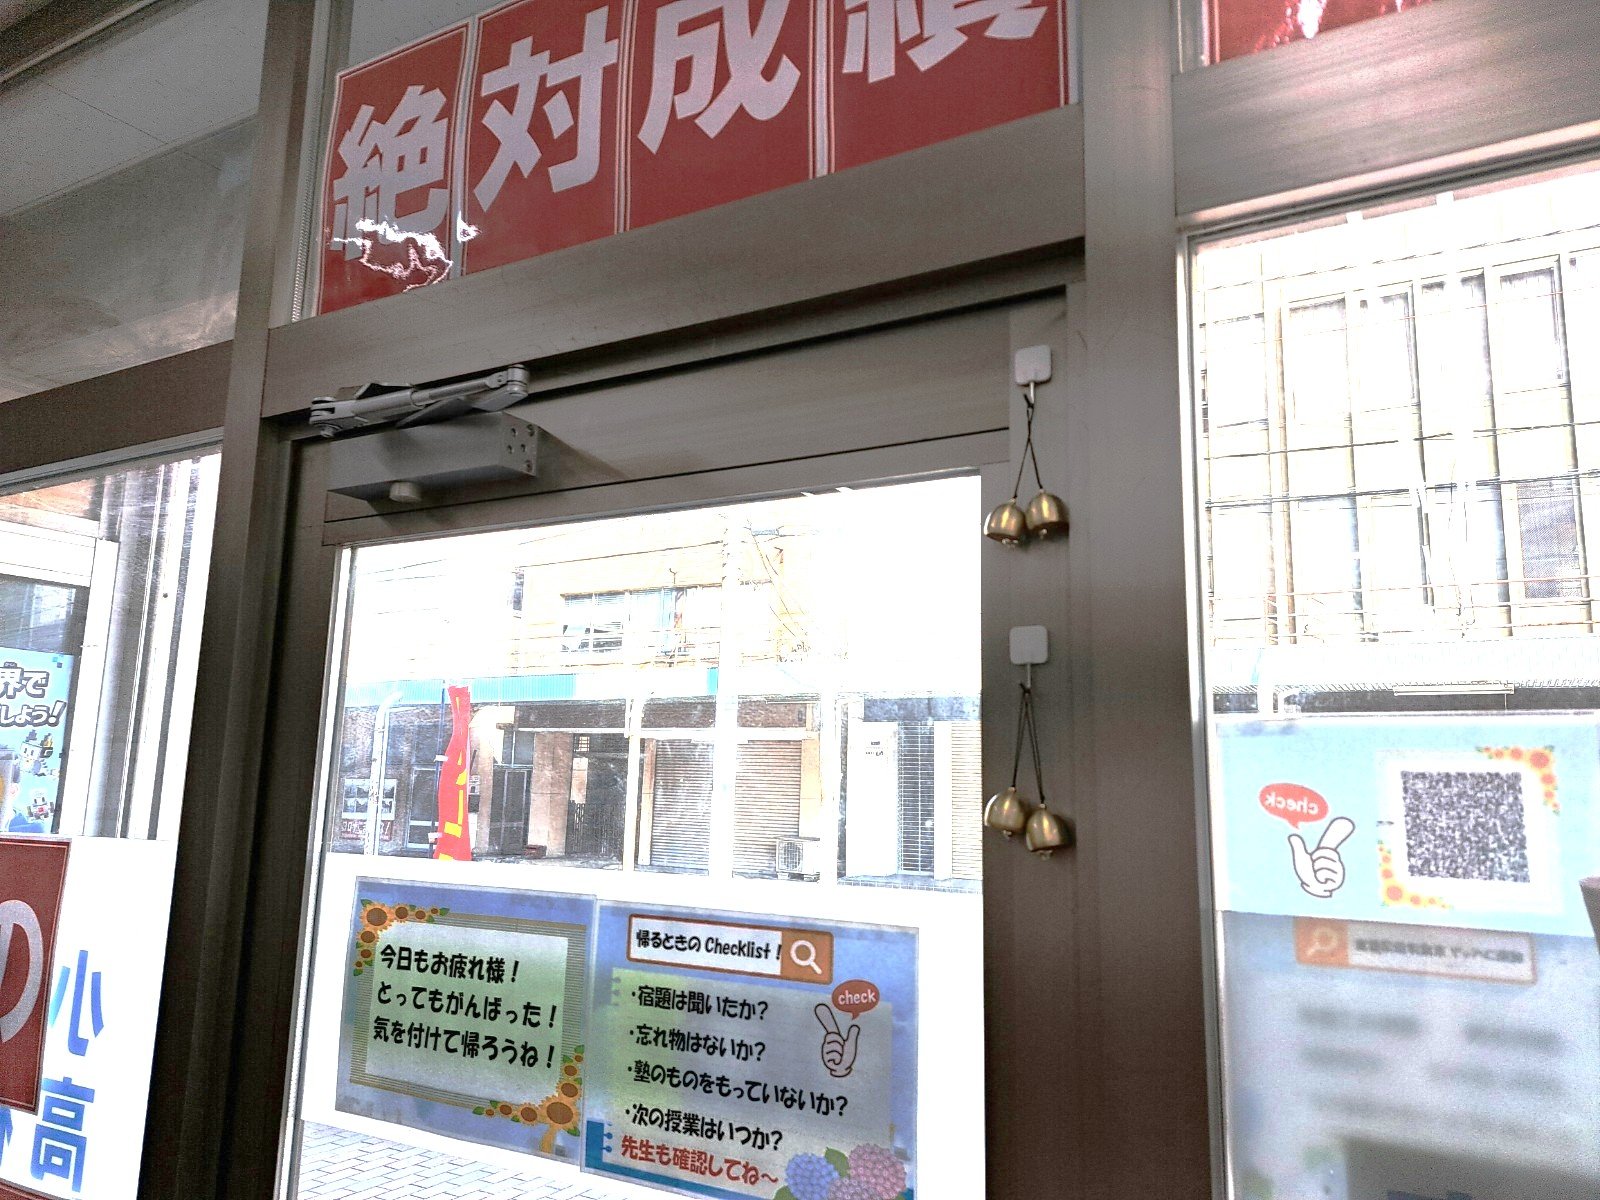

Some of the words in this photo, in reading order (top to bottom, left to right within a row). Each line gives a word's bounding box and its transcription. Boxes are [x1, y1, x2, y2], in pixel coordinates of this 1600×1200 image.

[636, 929, 701, 952] 帰るときの
[380, 944, 520, 984] 今日もお疲れ様！
[376, 981, 558, 1028] とってもがんばった！
[837, 989, 877, 1006] check
[372, 1015, 556, 1068] 気を付けて帰ろうね！
